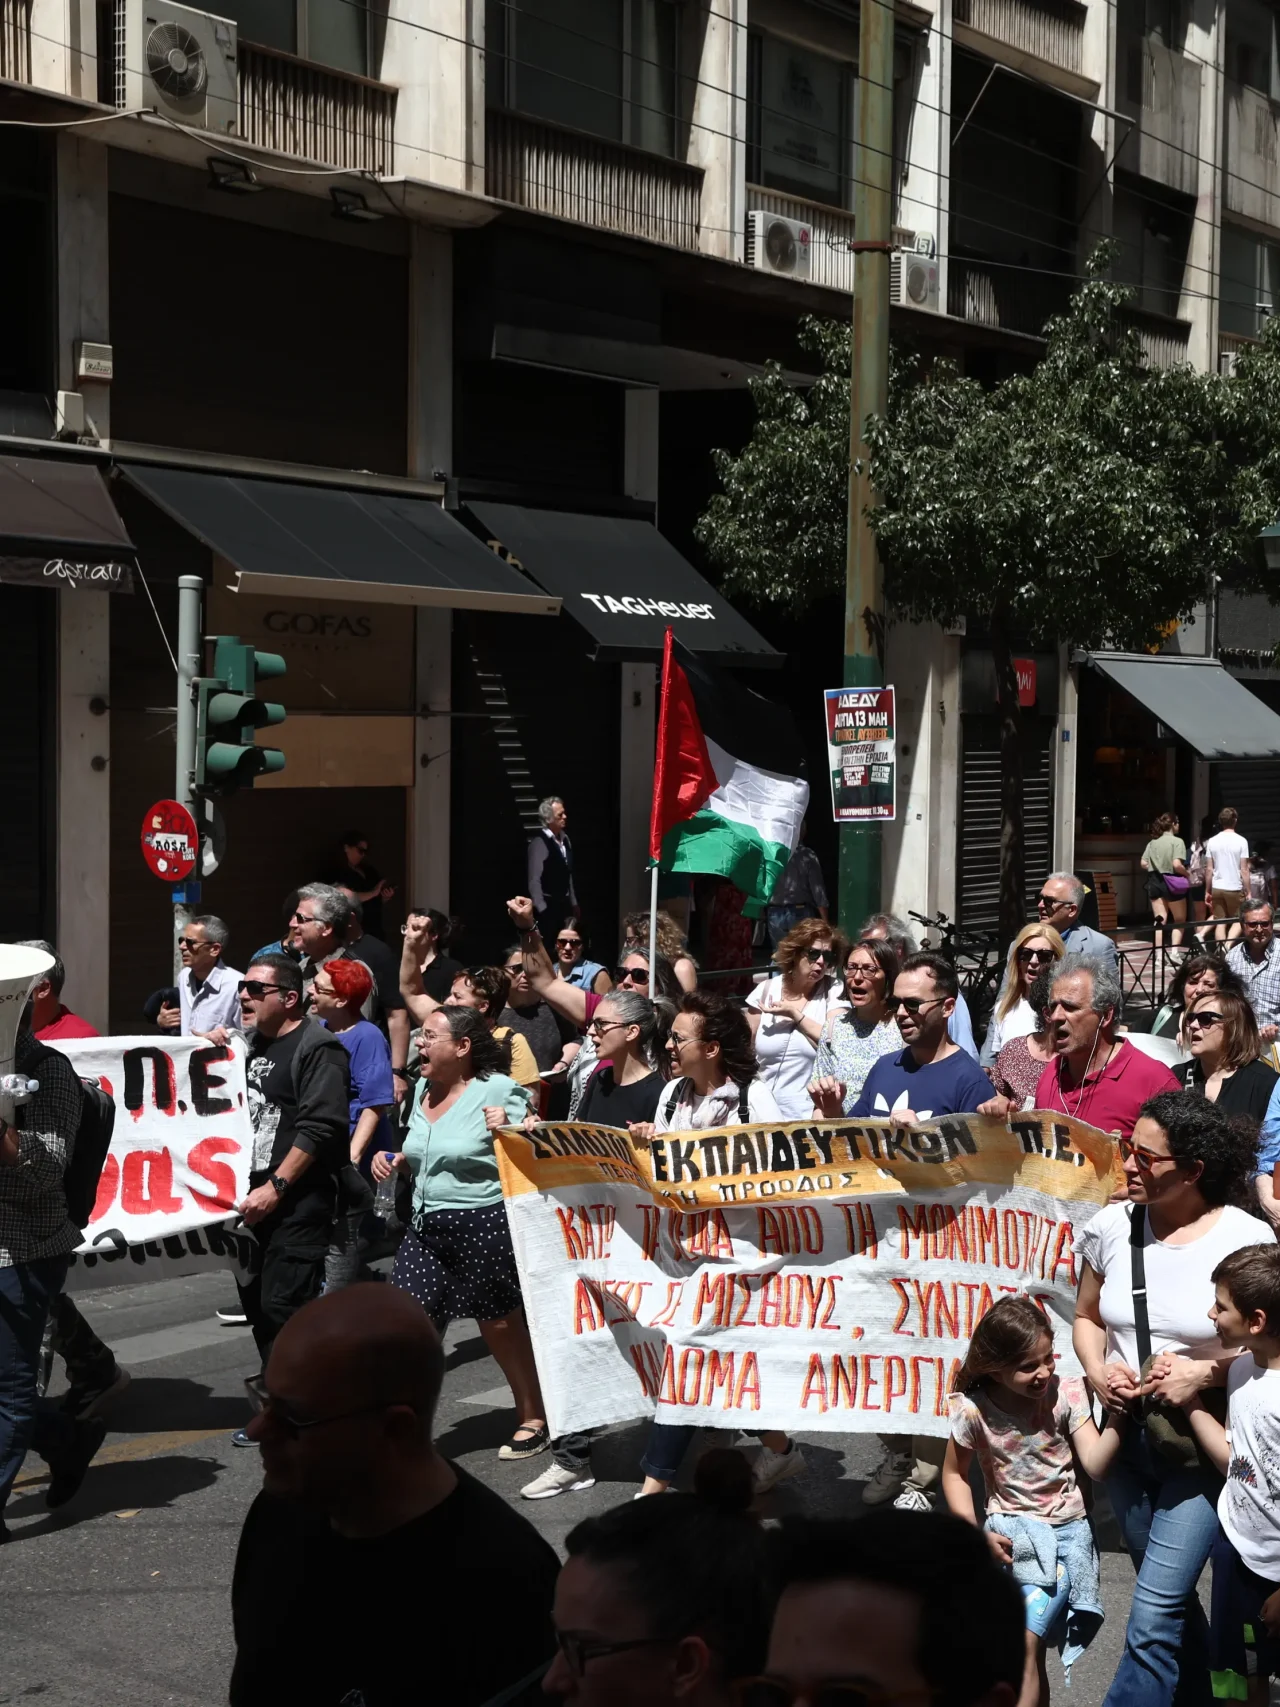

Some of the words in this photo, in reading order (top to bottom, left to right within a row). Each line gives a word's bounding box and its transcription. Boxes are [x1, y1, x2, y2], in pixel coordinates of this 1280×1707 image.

[262, 610, 372, 637] GOFAS
[855, 710, 866, 727] 13
[756, 1204, 824, 1258] ΑΠΟ
[833, 1201, 878, 1261] ΤΗ
[896, 1203, 1078, 1287] ΜΟΝΙΜΟΤΗΤΑ
